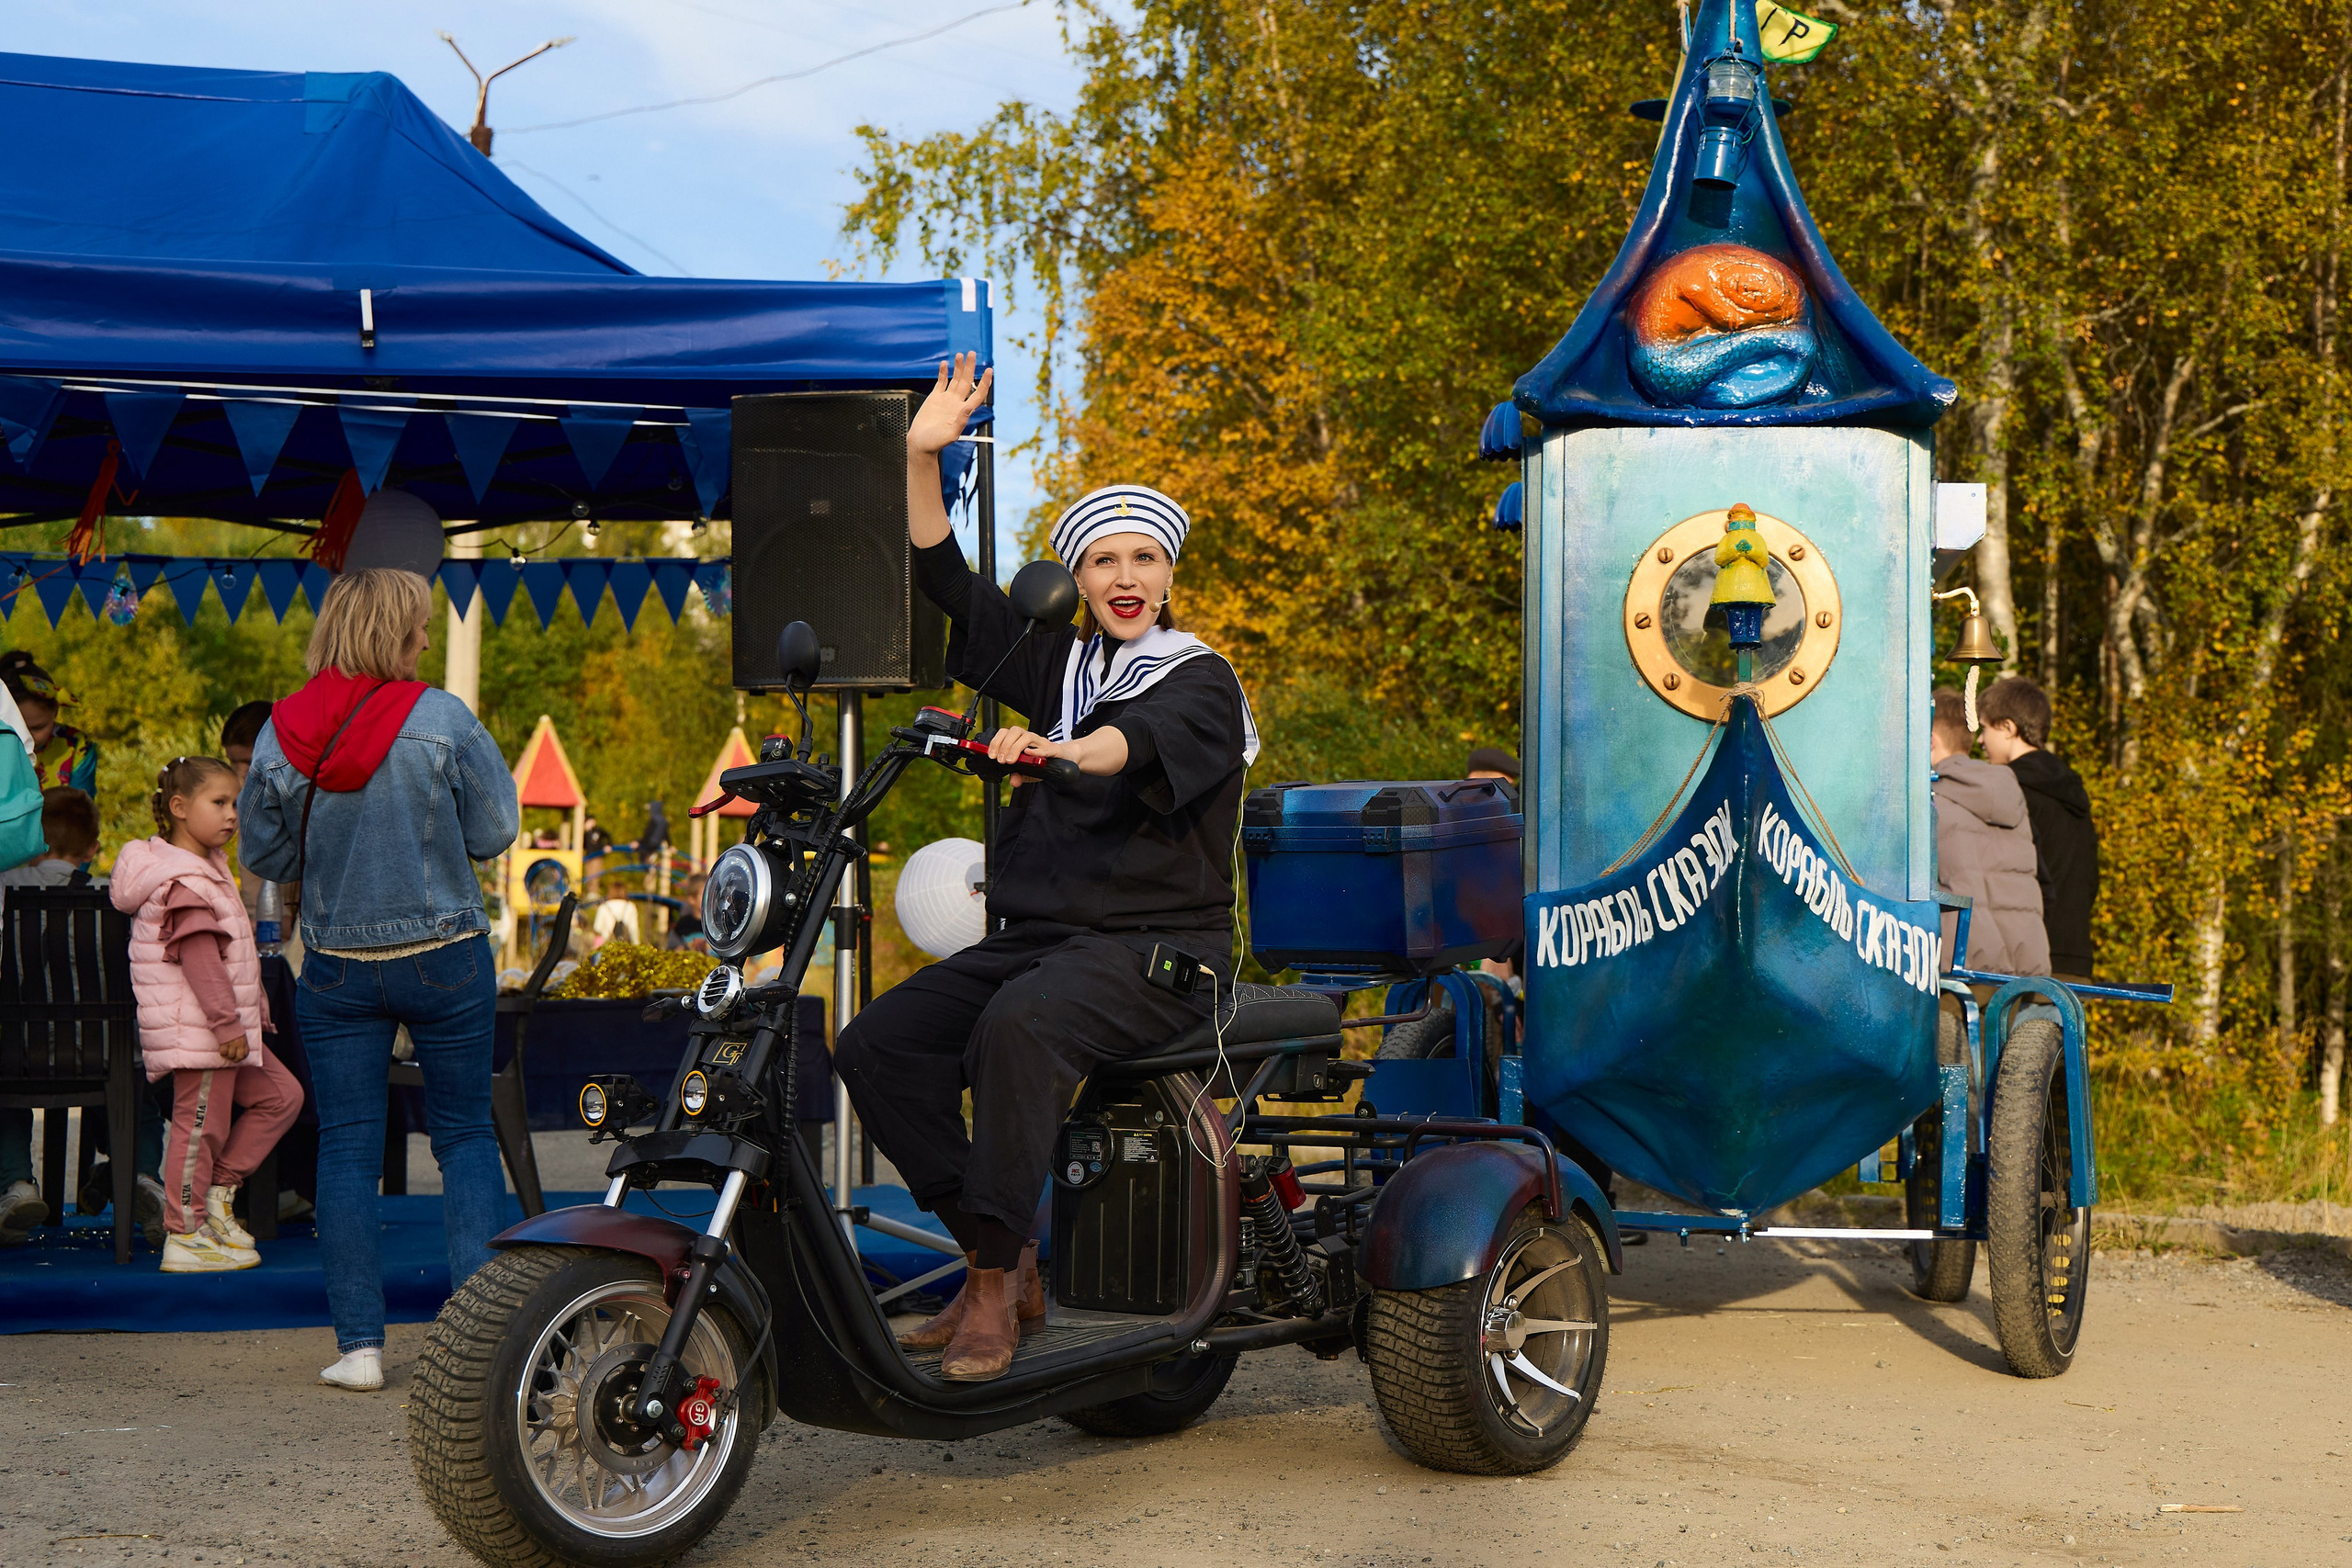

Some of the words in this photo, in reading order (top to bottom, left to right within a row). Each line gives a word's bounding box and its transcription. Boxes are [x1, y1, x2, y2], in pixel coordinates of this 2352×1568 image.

[1536, 886, 1655, 968] КОРАБЛЬ
[1646, 798, 1740, 931] СКАЗОК
[1757, 801, 1853, 942] КОРАБЛЬ
[1856, 899, 1942, 999] СКАЗОК
[721, 1043, 744, 1066] GT
[694, 1403, 705, 1423] GR
